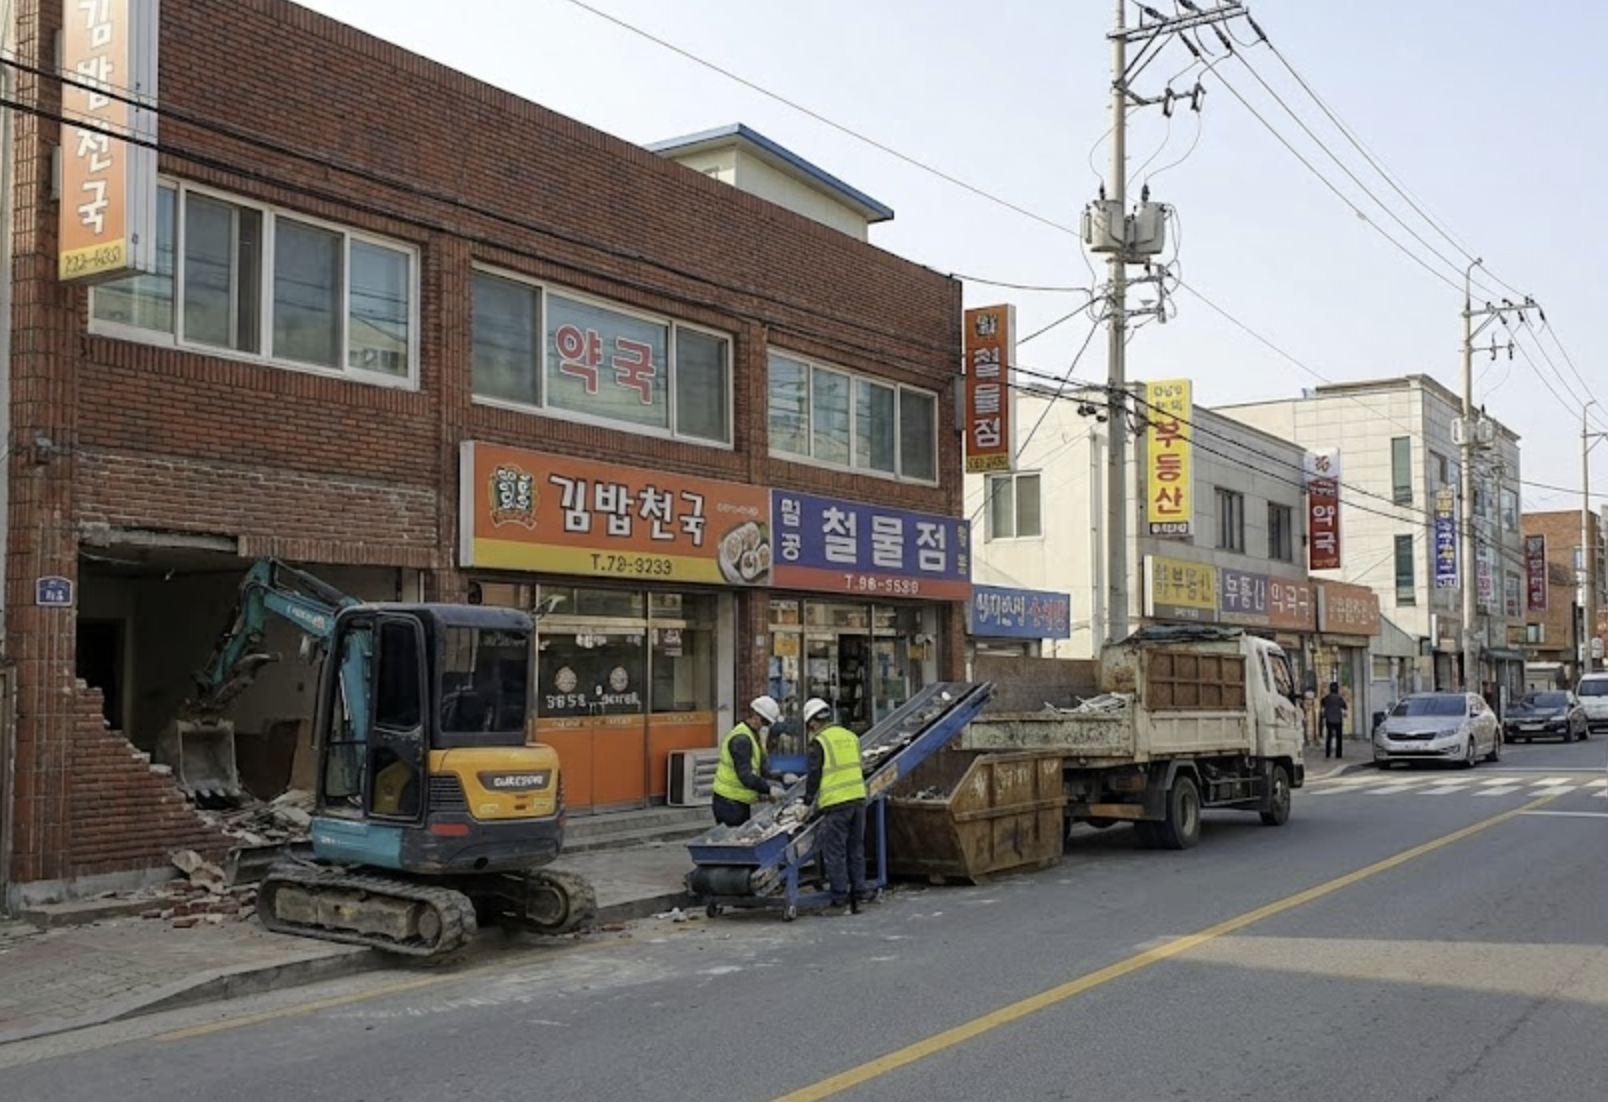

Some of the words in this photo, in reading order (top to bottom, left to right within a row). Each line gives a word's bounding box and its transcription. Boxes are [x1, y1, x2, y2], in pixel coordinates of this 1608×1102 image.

[77, 0, 114, 235] 김밥천국
[555, 323, 656, 405] 약국
[548, 473, 706, 547] 김밥천국
[821, 506, 947, 573] 철물점
